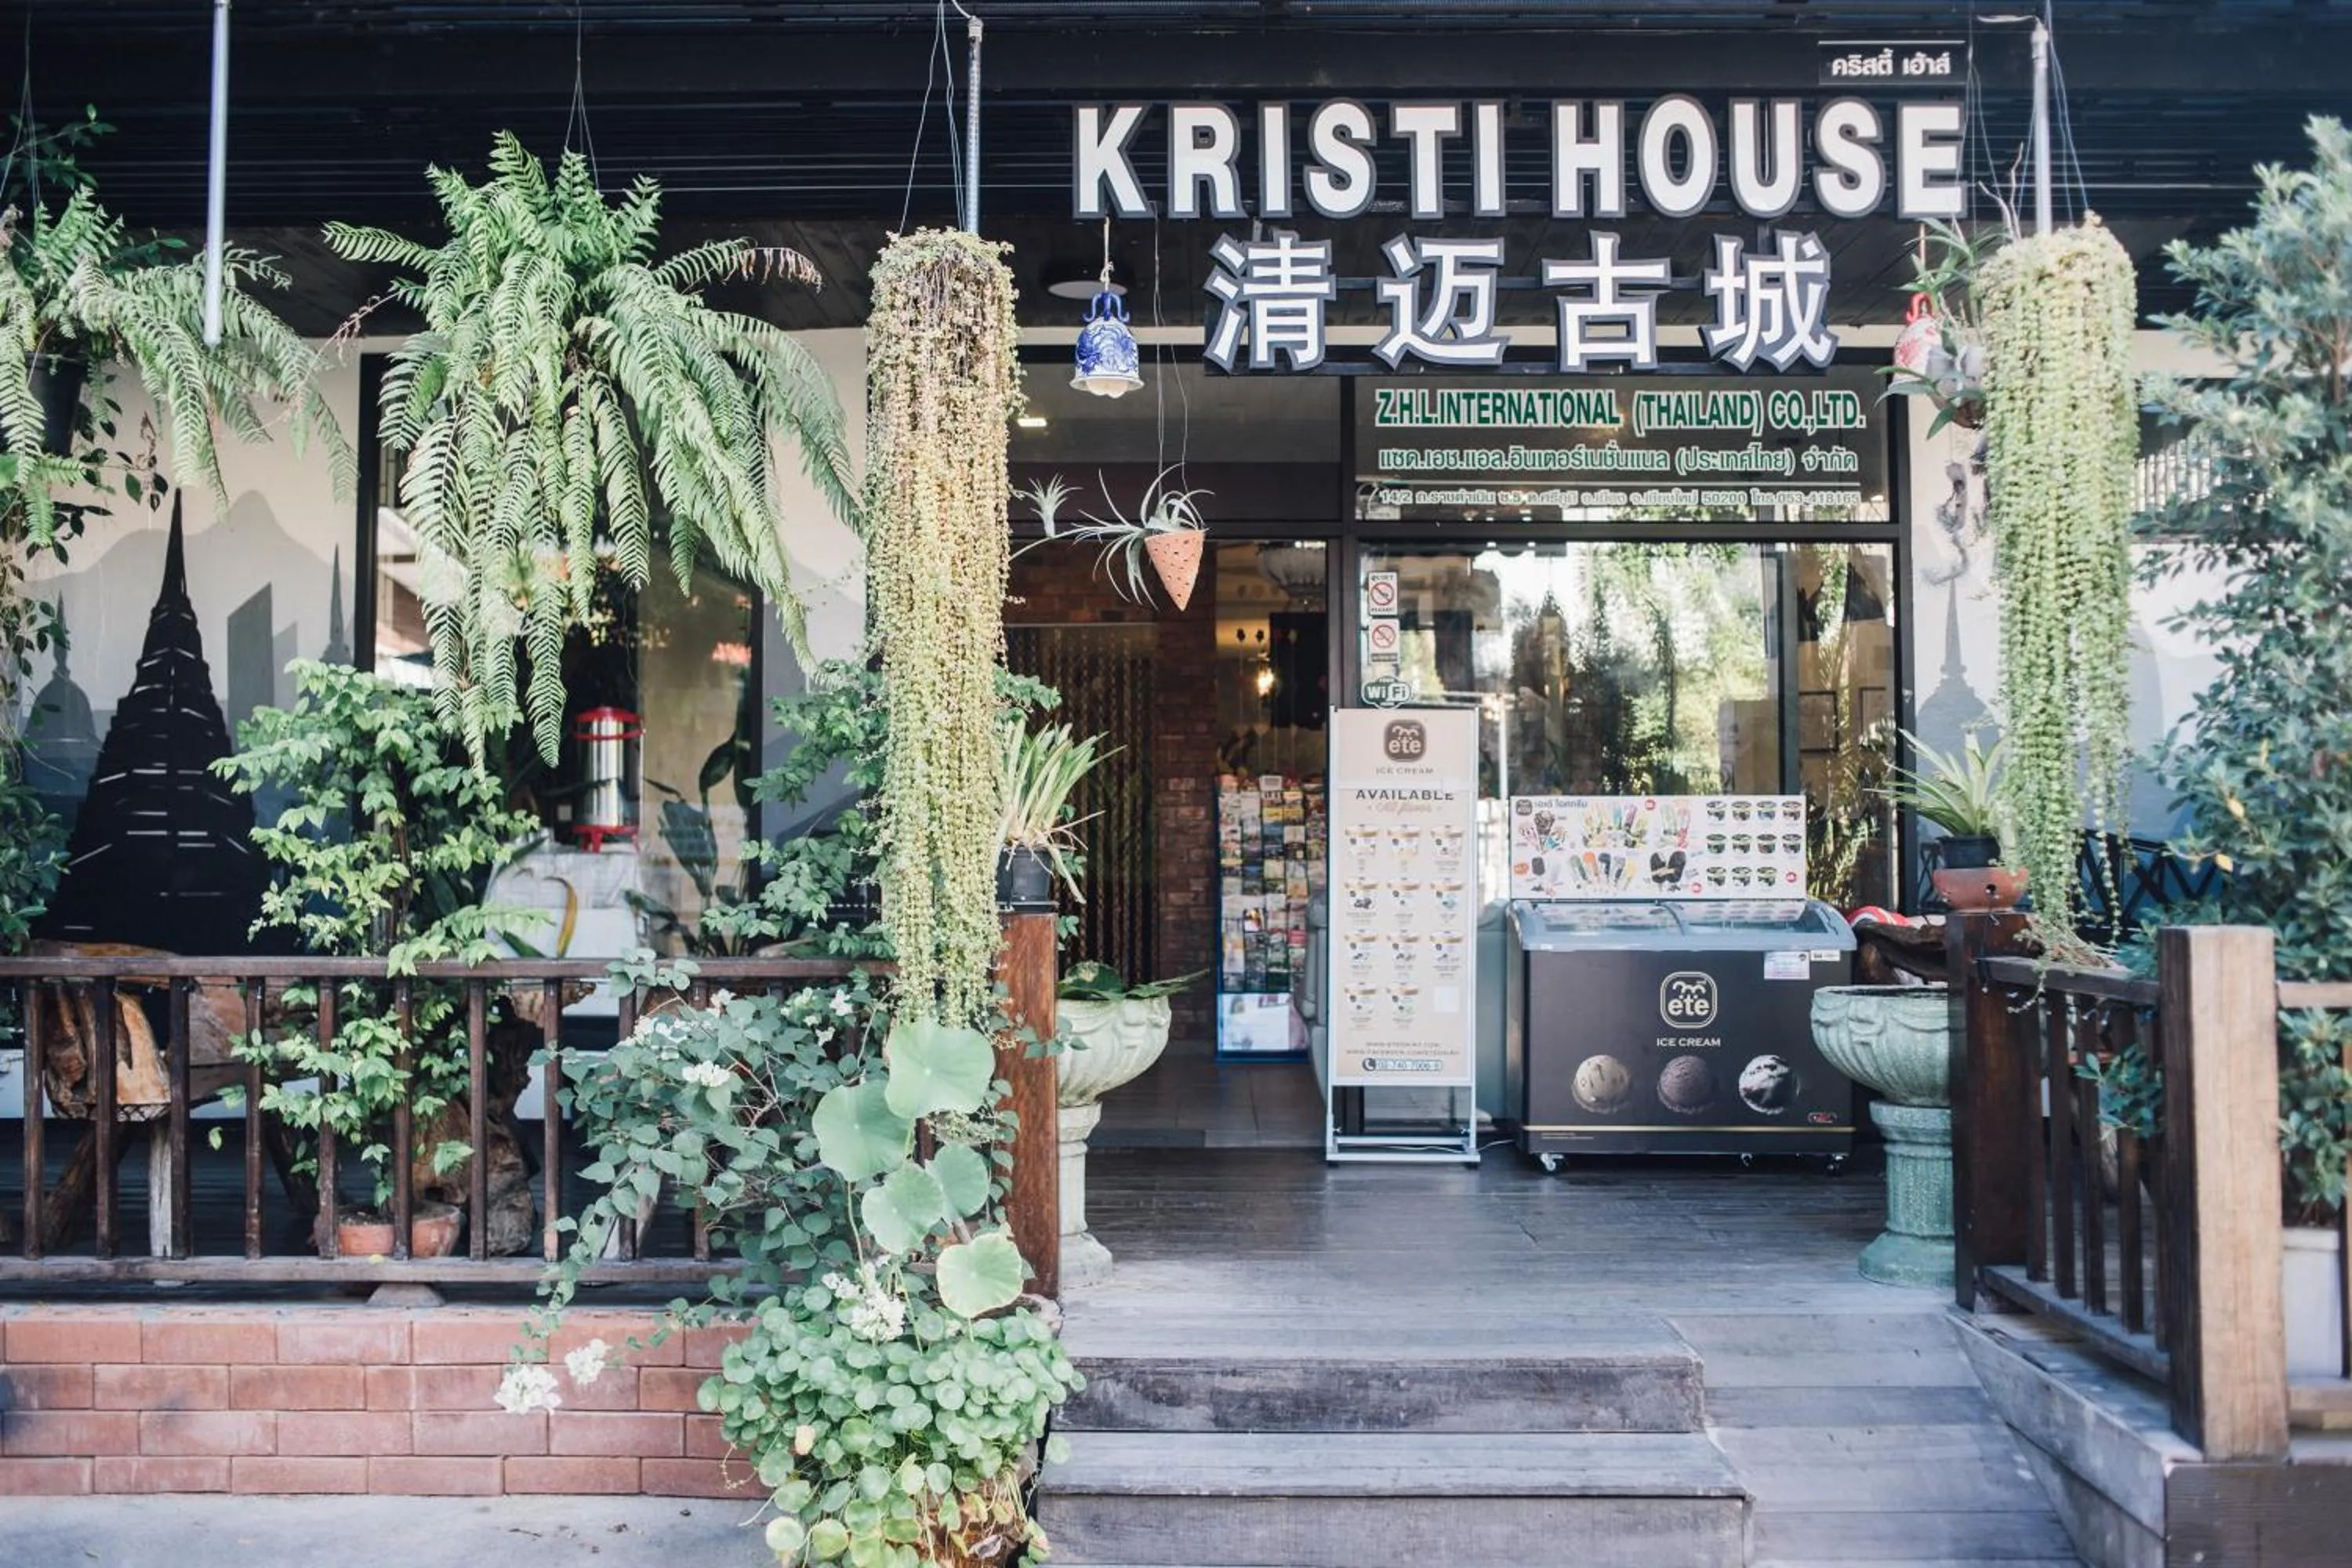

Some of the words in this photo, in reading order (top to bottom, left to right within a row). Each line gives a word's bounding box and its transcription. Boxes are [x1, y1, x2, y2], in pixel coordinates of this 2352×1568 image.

[1831, 47, 1893, 76] คริสตี้
[1073, 98, 1506, 219] KRISTI
[1552, 93, 1968, 219] HOUSE
[1204, 229, 1839, 375] 清迈古城
[1633, 390, 1762, 437] (THAILAND)
[1769, 390, 1867, 436] CO.,LTD.
[1675, 441, 1795, 475] (ประเทศไทย)
[1802, 445, 1859, 471] จำกัด
[1701, 490, 1748, 506] 50200
[1356, 789, 1454, 800] AVAILABLE
[1657, 1037, 1677, 1047] ICE
[1679, 1037, 1721, 1047] CREAM
